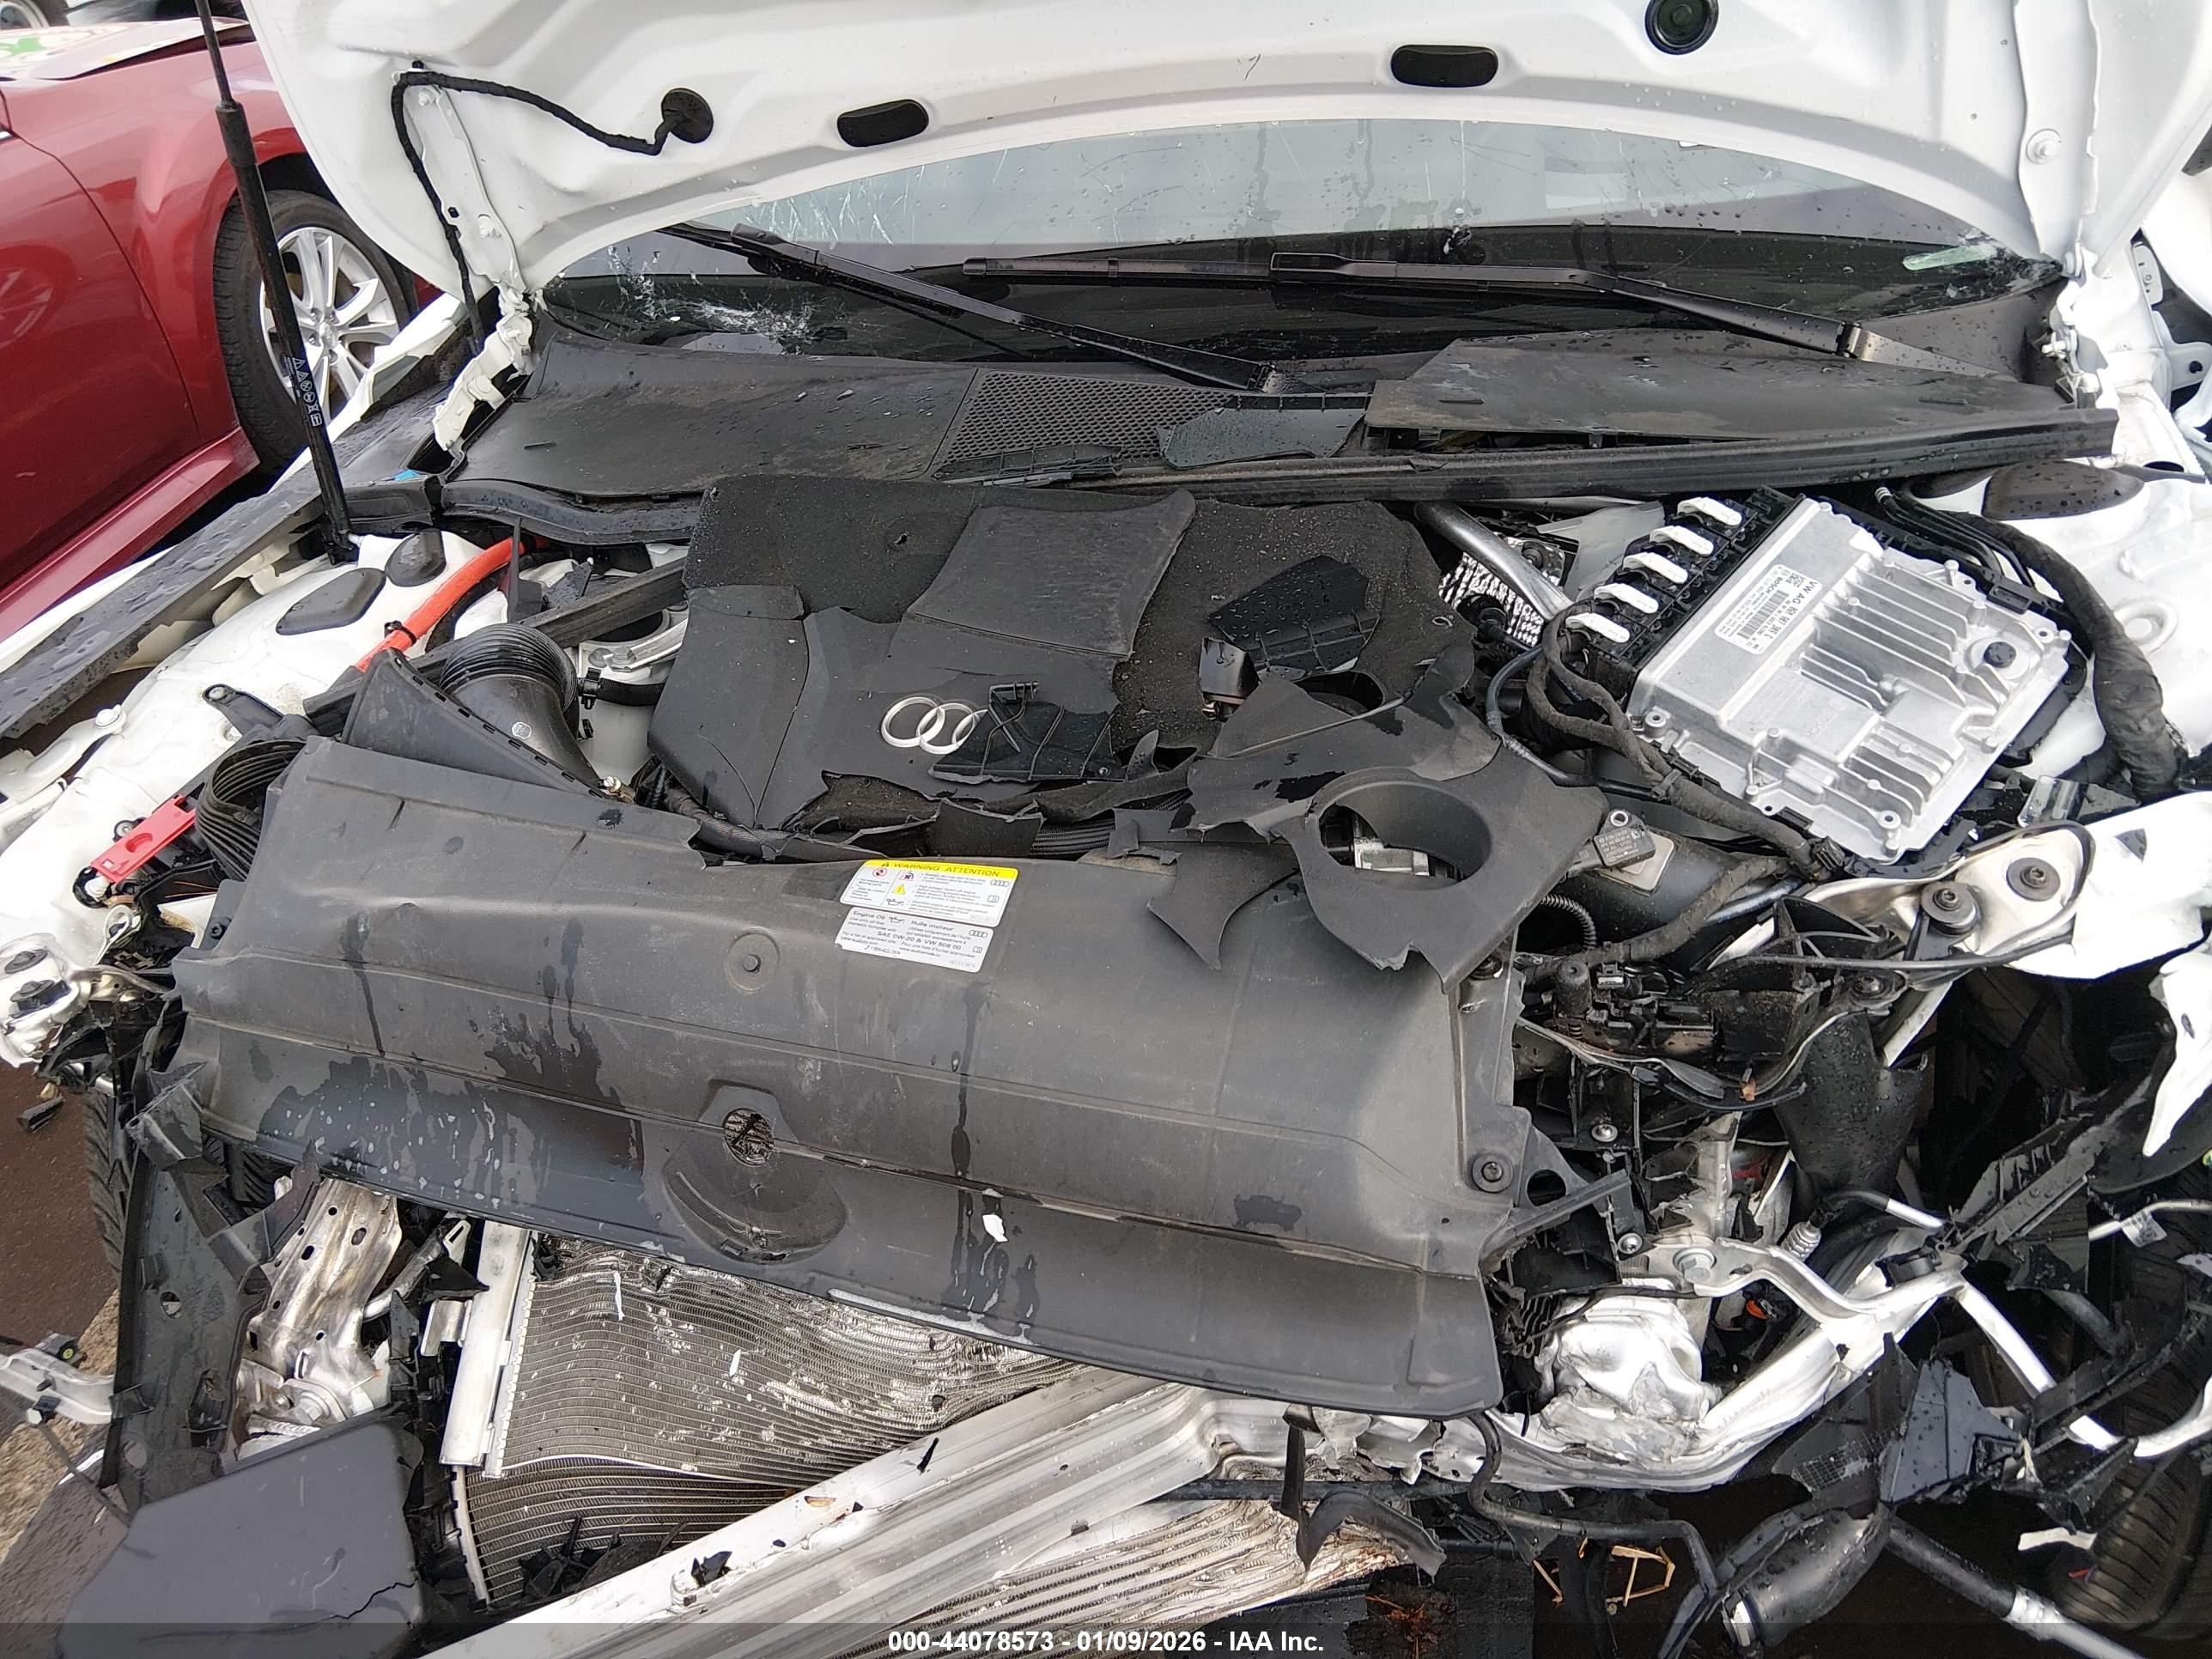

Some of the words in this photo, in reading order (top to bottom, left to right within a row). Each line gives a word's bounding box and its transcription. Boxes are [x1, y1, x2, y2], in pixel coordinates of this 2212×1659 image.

[1765, 576, 1783, 594] BOSCH
[1802, 580, 1817, 594] VW
[1791, 592, 1805, 605] AG
[893, 862, 939, 872] WARNING
[945, 867, 1000, 877] ATTENTION
[853, 910, 874, 919] Engine
[928, 922, 954, 931] moteur
[892, 933, 915, 942] 0W-20
